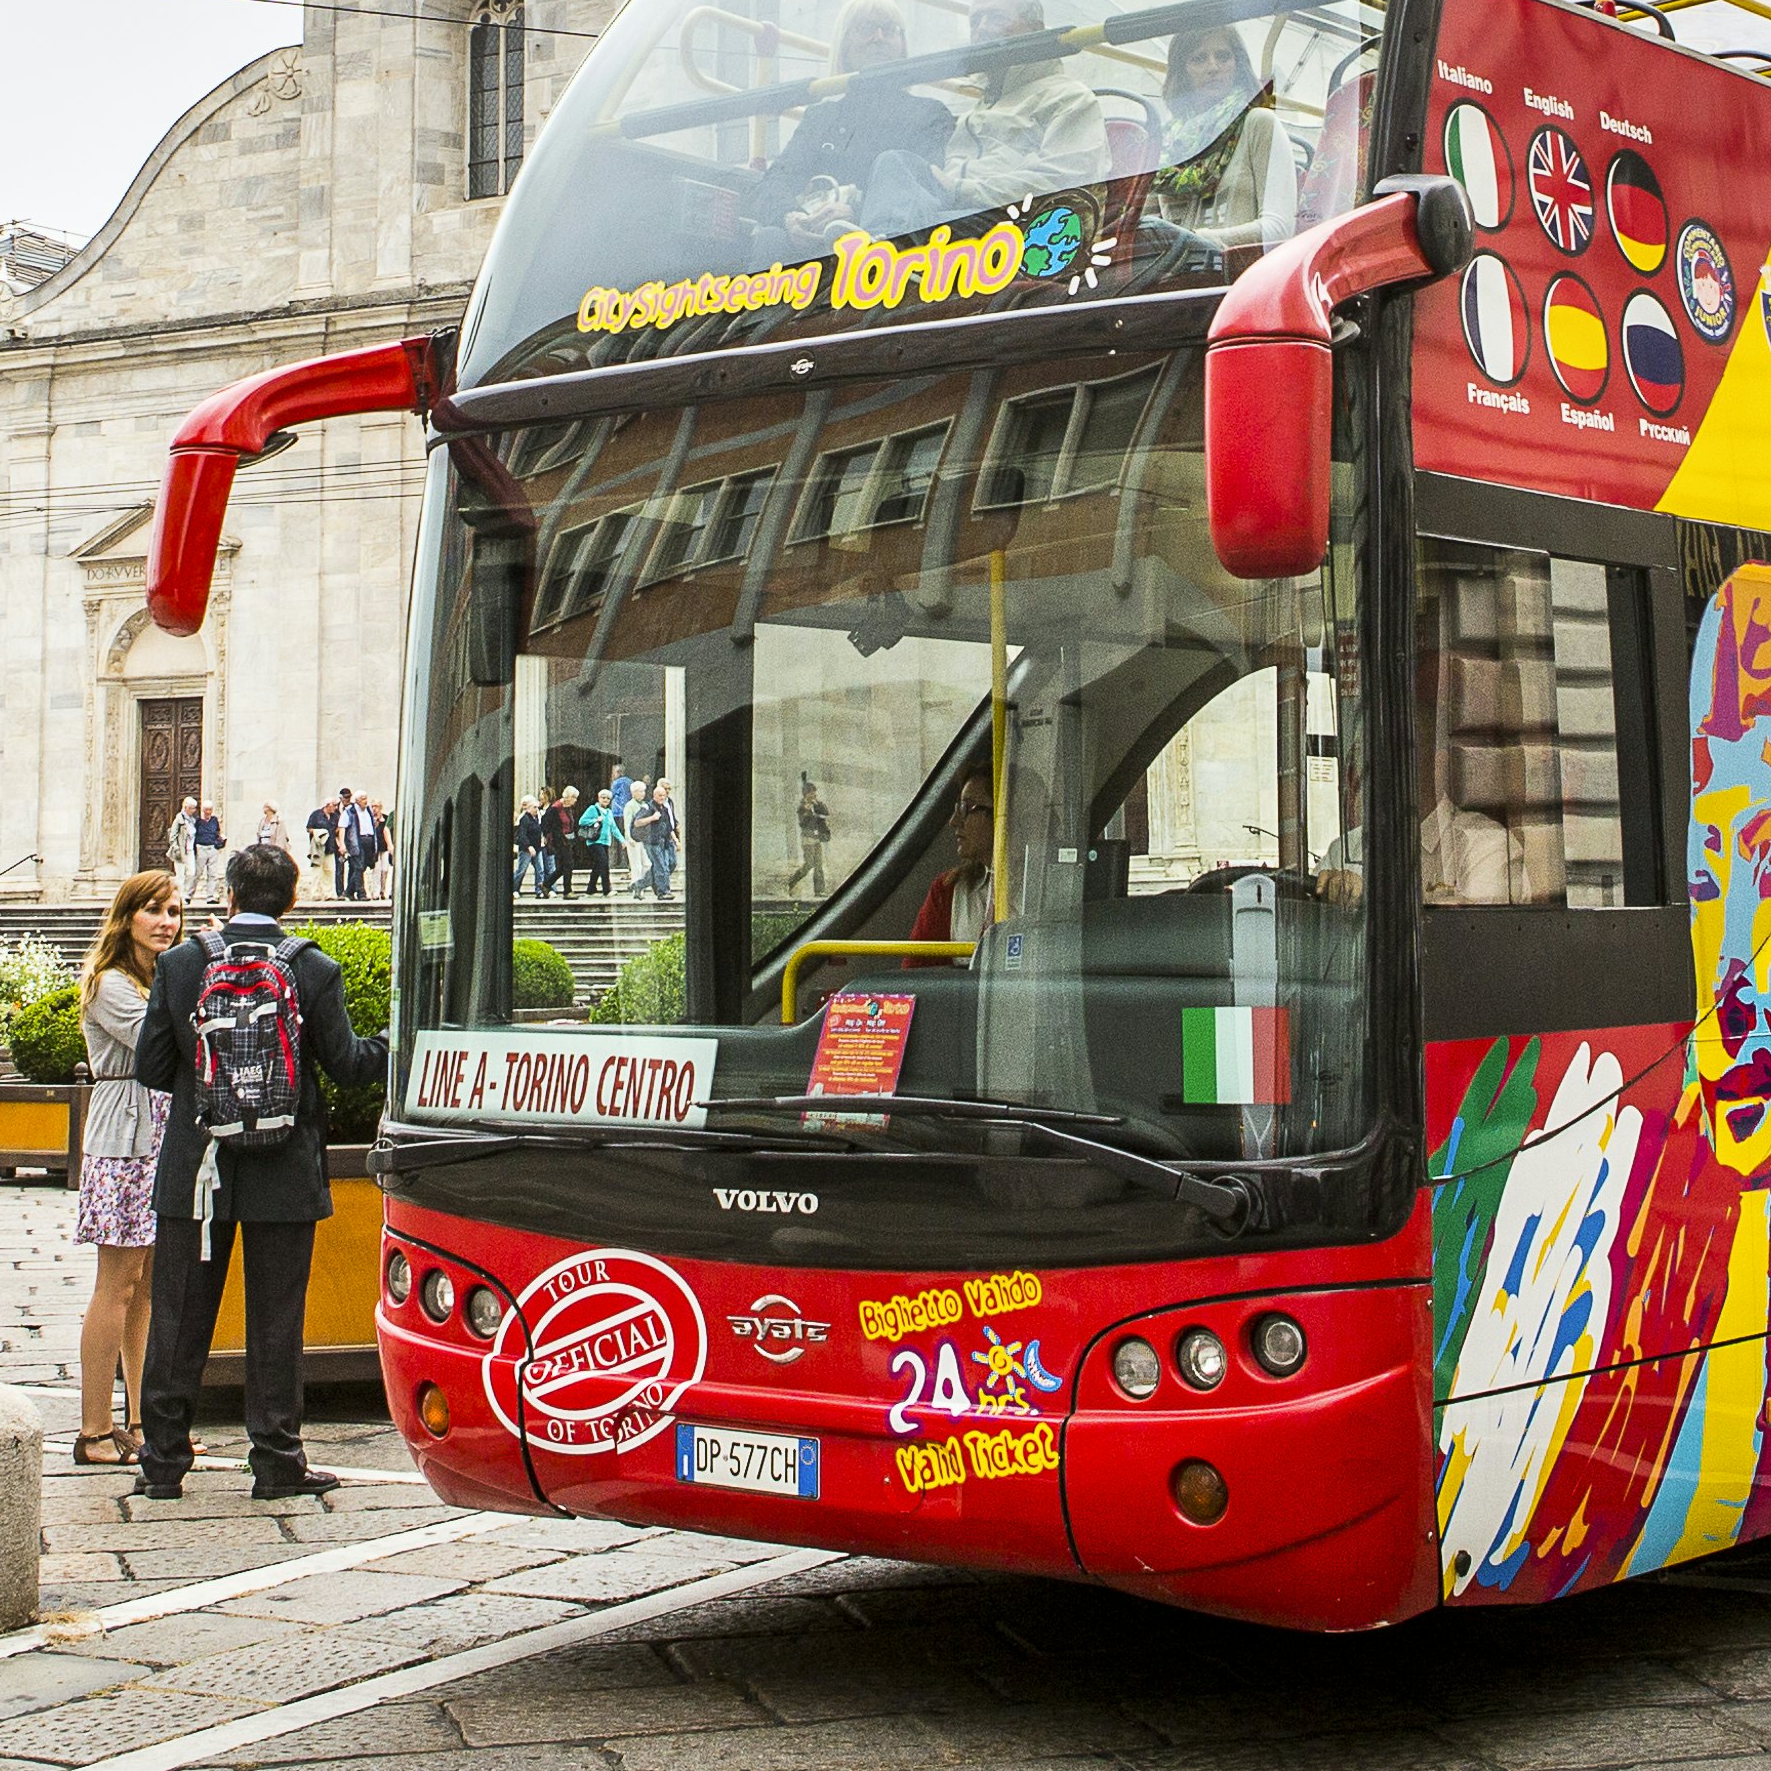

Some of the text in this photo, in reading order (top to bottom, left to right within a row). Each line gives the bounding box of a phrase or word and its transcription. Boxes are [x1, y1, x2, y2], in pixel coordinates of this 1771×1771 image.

[1437, 59, 1493, 95] Italiano
[1523, 87, 1575, 120] English
[1599, 111, 1653, 144] Deutsch
[575, 223, 1025, 334] CitySightseeing Torino
[1695, 306, 1727, 327] JUNIOR
[1467, 382, 1530, 415] Français
[1560, 402, 1615, 432] Español
[417, 1050, 469, 1109] LINE
[468, 1051, 489, 1110] A
[501, 1051, 590, 1115] TORINO
[596, 1055, 695, 1122] CENTRO
[713, 1188, 819, 1214] VOLVO
[543, 1260, 611, 1302] TOUR
[859, 1270, 1042, 1342] Biglietto Valido
[726, 1314, 831, 1342] ayats
[524, 1315, 667, 1385] OFFICIAL
[889, 1343, 972, 1434] 24
[547, 1382, 663, 1444] OF TORINO
[896, 1422, 1060, 1493] Valid Ticket
